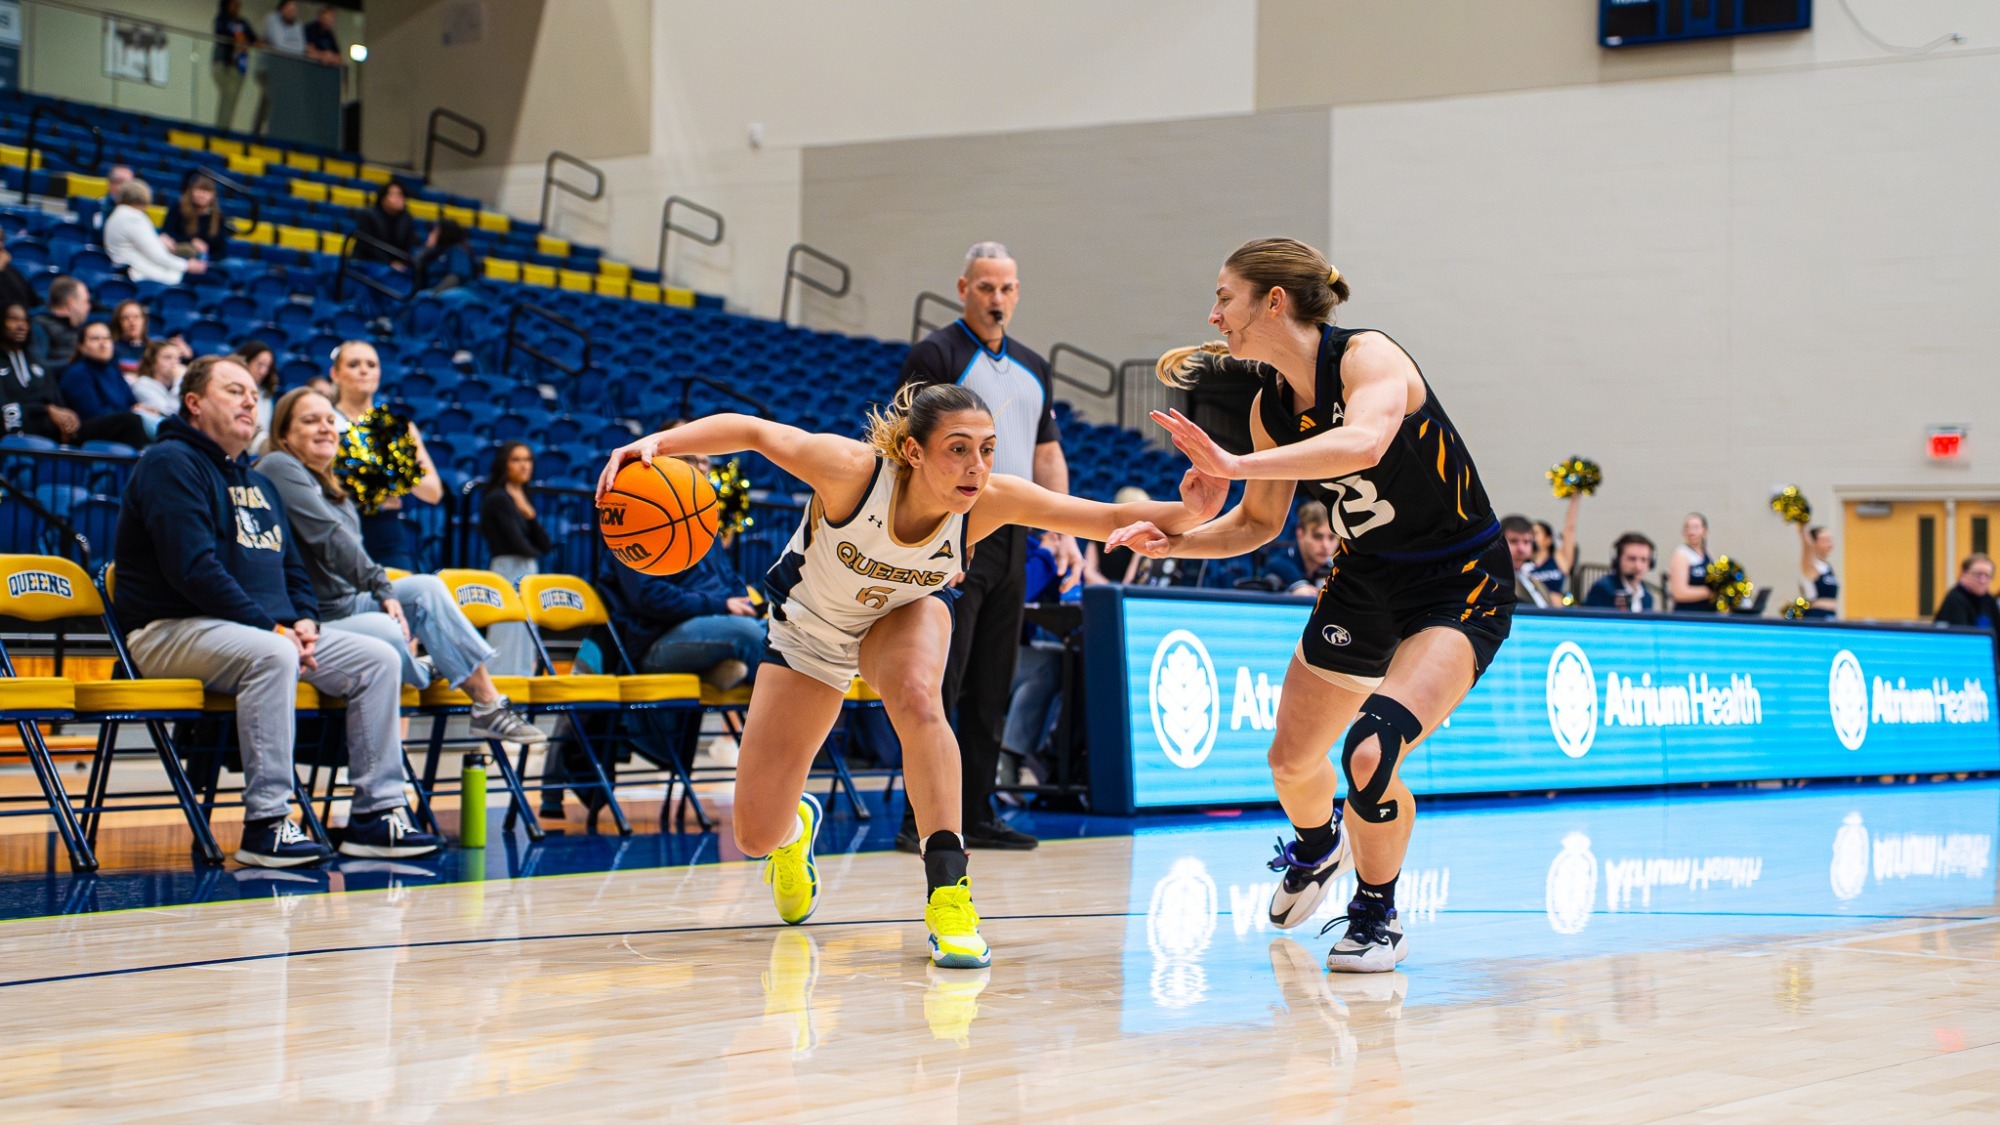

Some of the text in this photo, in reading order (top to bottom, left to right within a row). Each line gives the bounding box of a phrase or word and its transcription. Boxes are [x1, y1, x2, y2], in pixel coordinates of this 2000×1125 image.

[836, 541, 948, 587] QUEENS
[8, 572, 73, 597] QUEENS
[457, 586, 503, 608] QUEENS
[540, 590, 584, 610] QUEENS
[855, 585, 897, 610] 6
